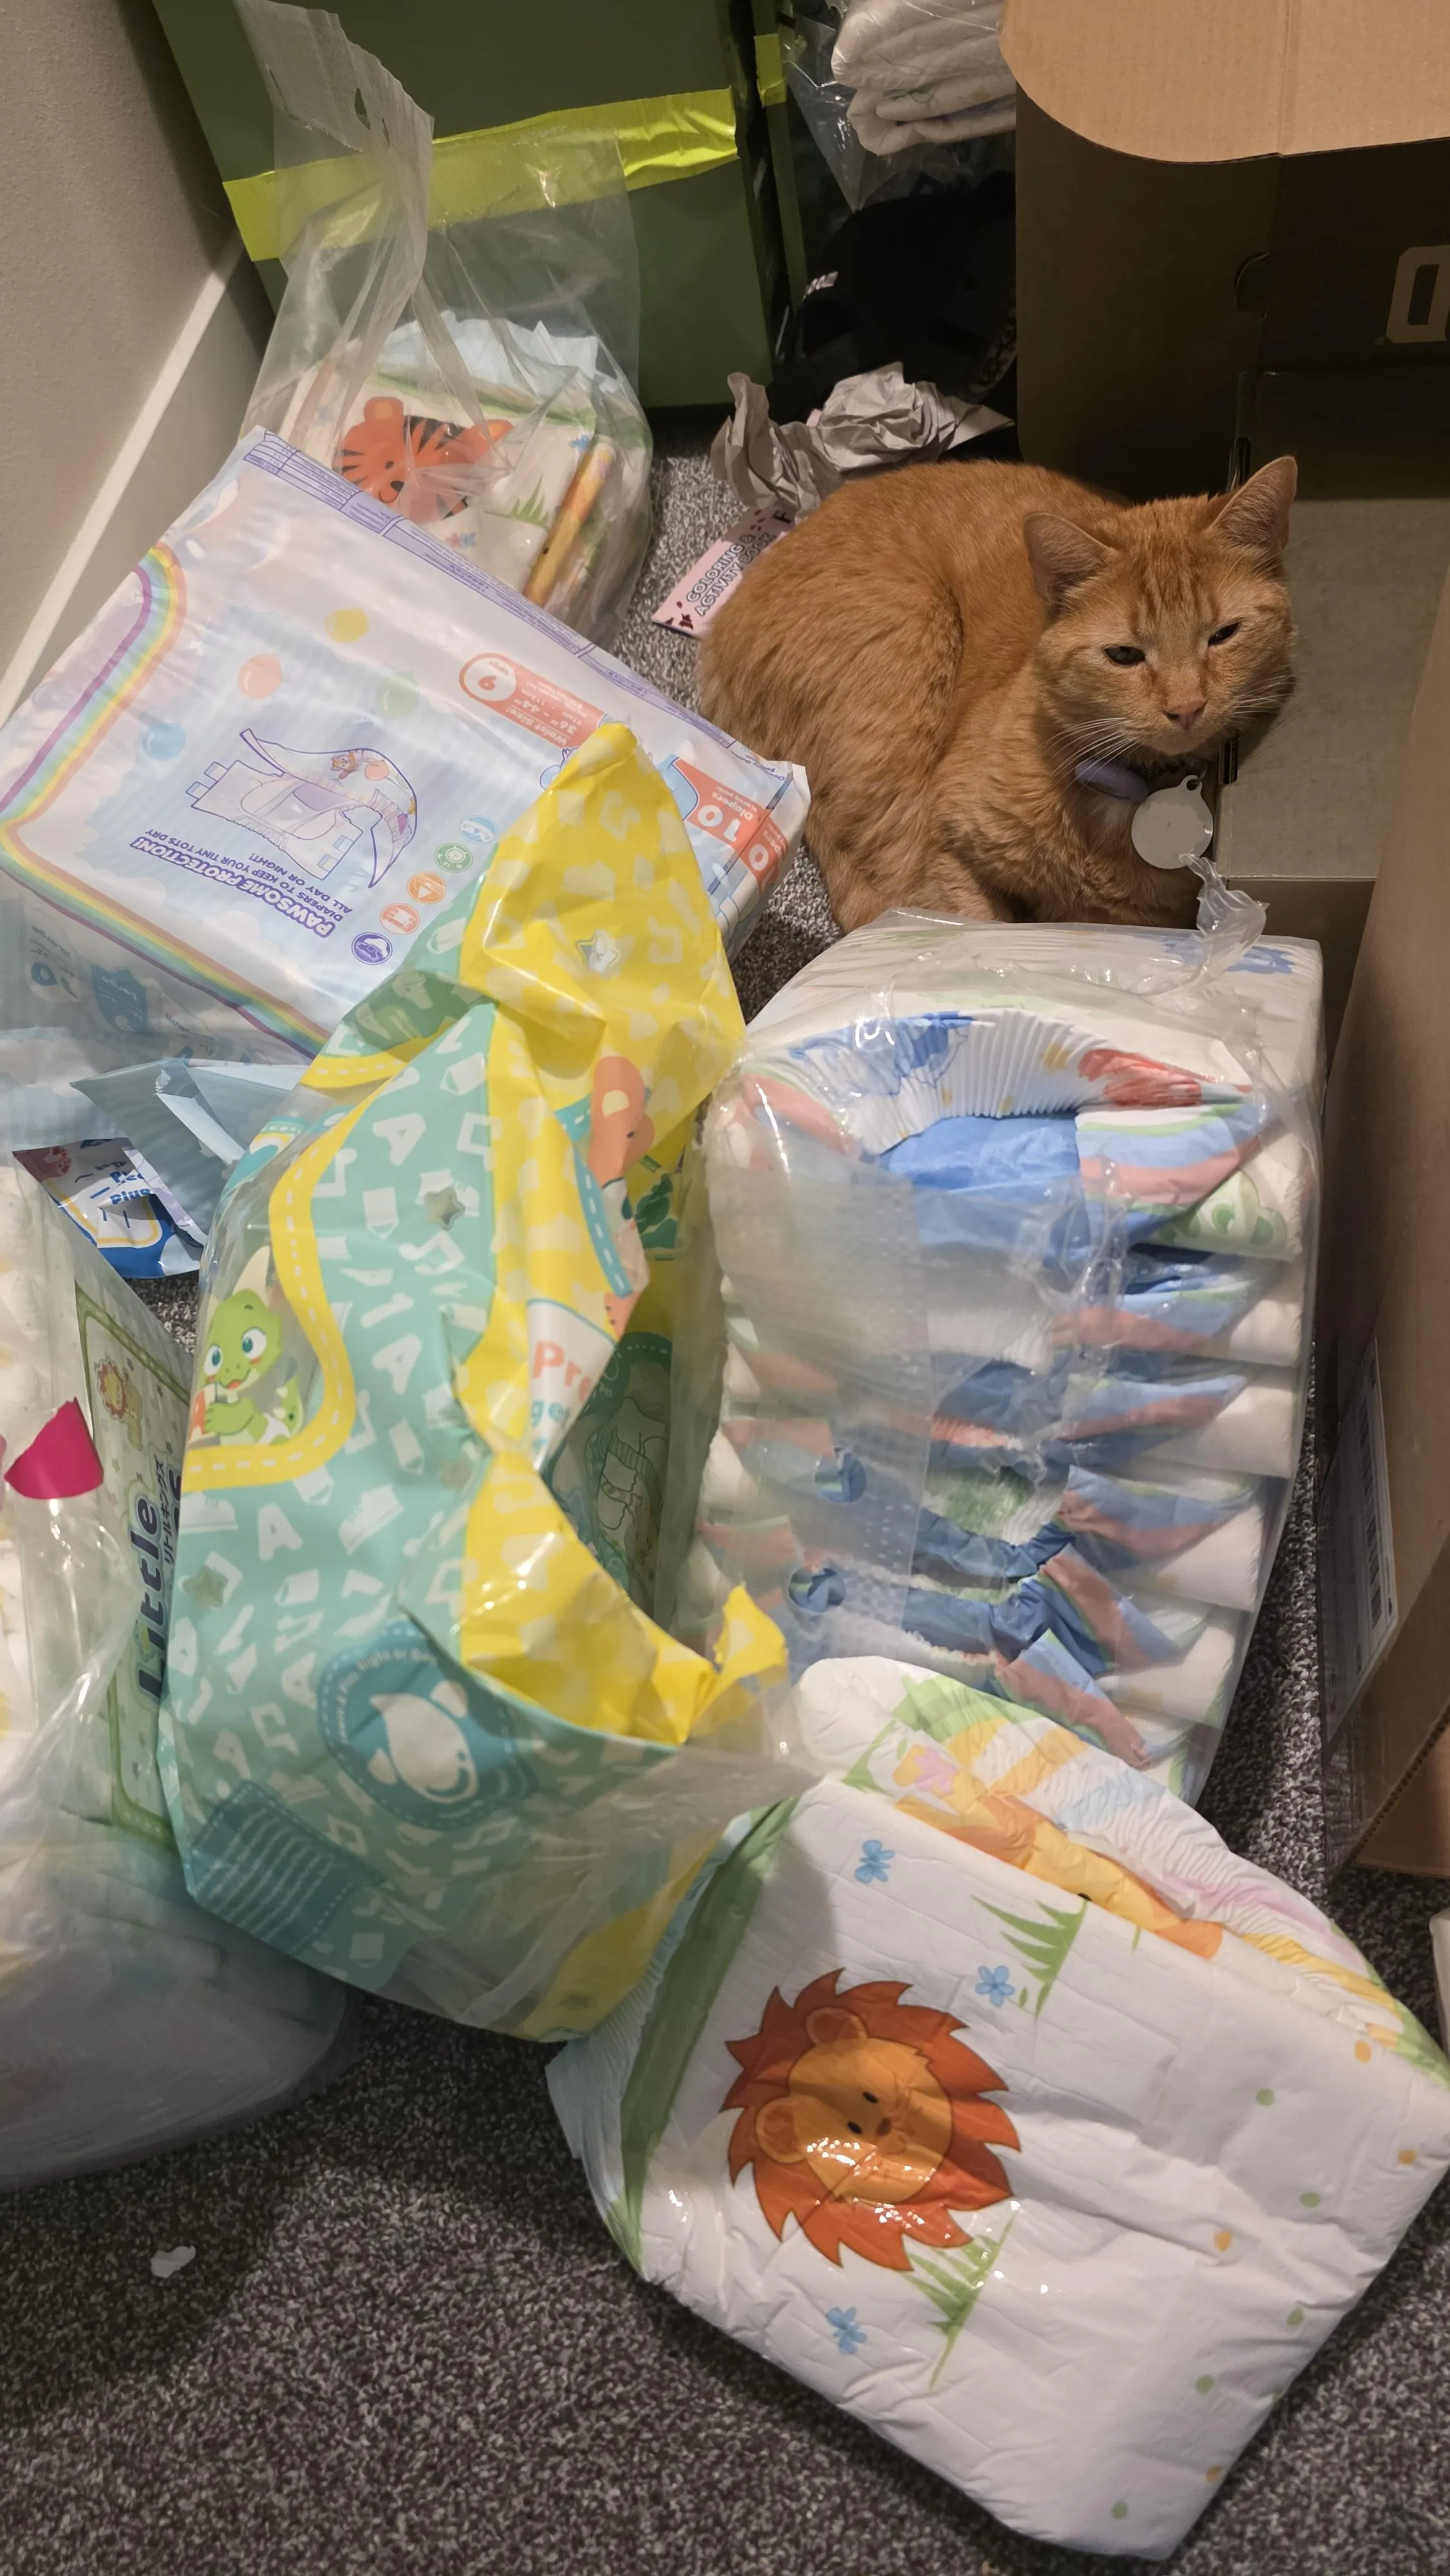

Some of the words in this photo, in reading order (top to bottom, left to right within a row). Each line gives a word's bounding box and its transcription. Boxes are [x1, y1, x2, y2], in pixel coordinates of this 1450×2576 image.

[685, 541, 745, 606] COLORING
[740, 531, 755, 545] &
[693, 561, 742, 617] ACTIVITY
[738, 529, 777, 565] BOOK
[505, 706, 534, 726] Size:
[534, 723, 568, 745] Waist
[710, 791, 755, 820] Diapers
[697, 804, 740, 840] 10
[144, 826, 170, 842] DRY
[166, 835, 196, 853] TOTS
[130, 834, 243, 889] PROTECTION!
[193, 845, 221, 863] TINY
[219, 854, 252, 875] YOUR
[247, 851, 289, 877] NIGHT!
[250, 866, 279, 885] KEEP
[277, 878, 297, 895] TO
[285, 871, 306, 887] OR
[304, 881, 332, 903] DAY
[239, 875, 335, 938] PAWSOME
[293, 888, 346, 922] DIAPERS
[329, 898, 353, 914] ALL
[131, 1495, 168, 1702] Little
